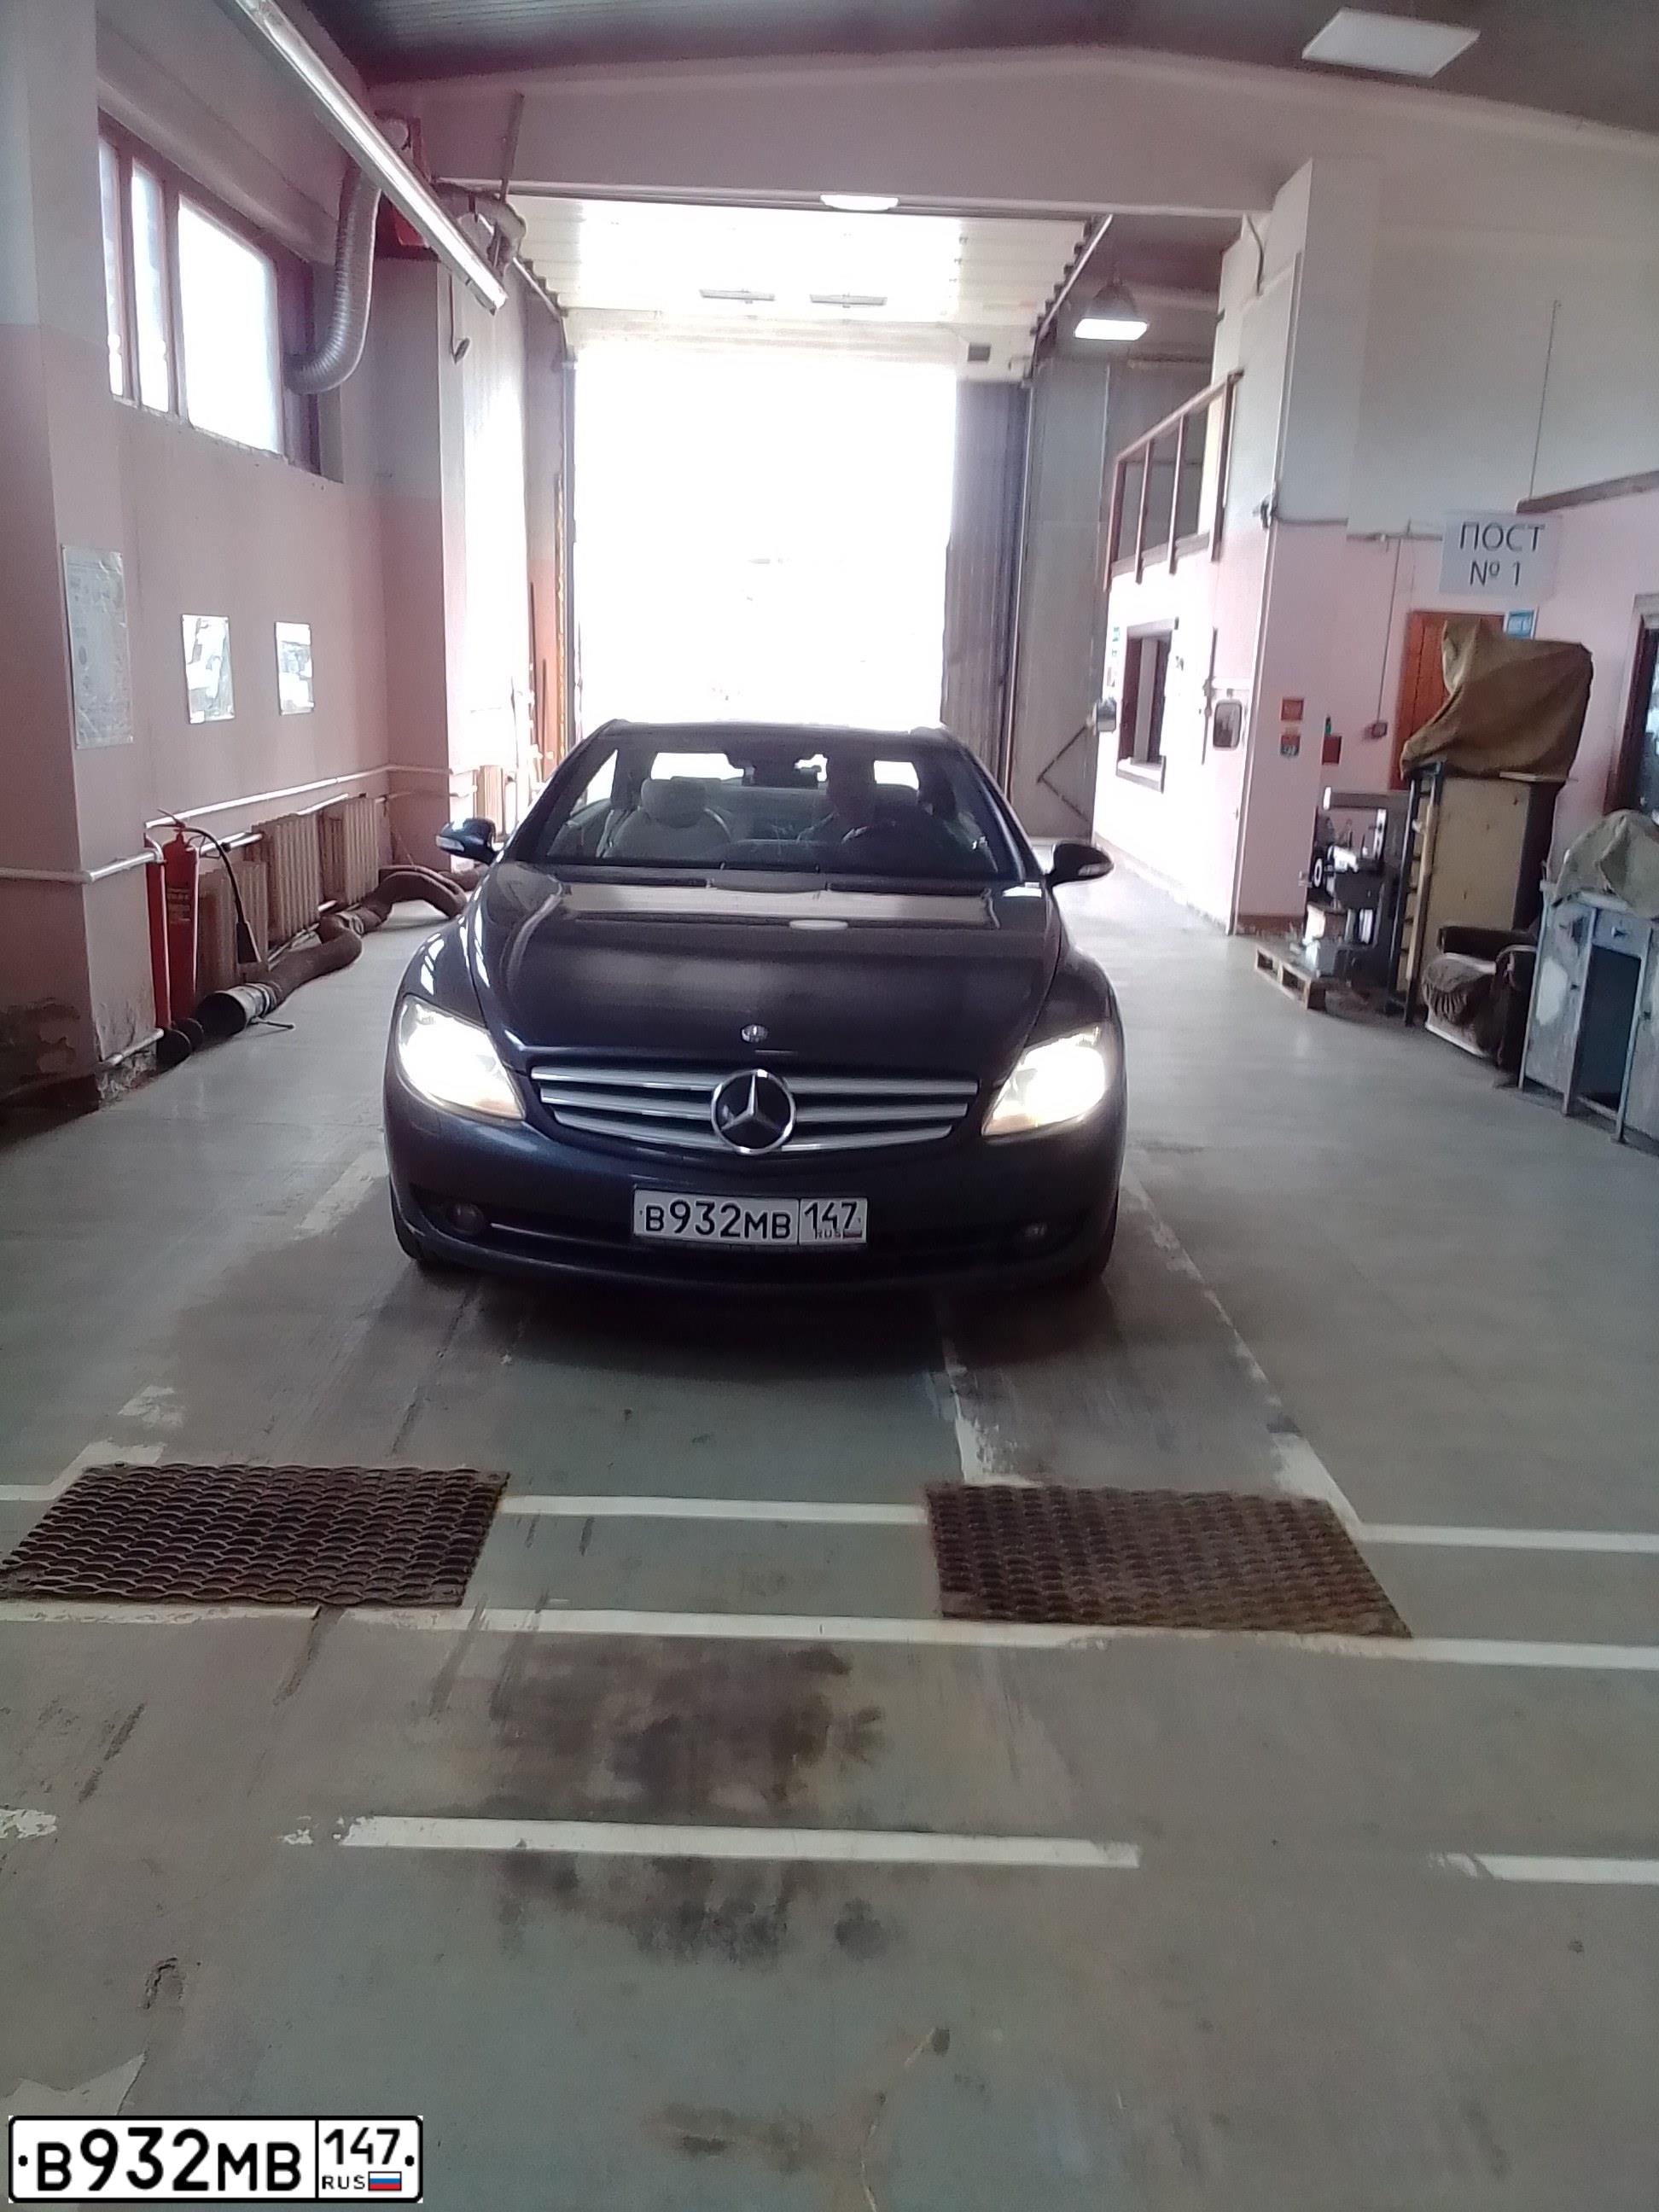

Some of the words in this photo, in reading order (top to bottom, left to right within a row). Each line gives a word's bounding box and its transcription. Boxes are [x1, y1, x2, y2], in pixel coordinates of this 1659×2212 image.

[1459, 521, 1545, 551] ПОСТ
[1511, 561, 1521, 586] 1
[804, 1202, 858, 1231] 147
